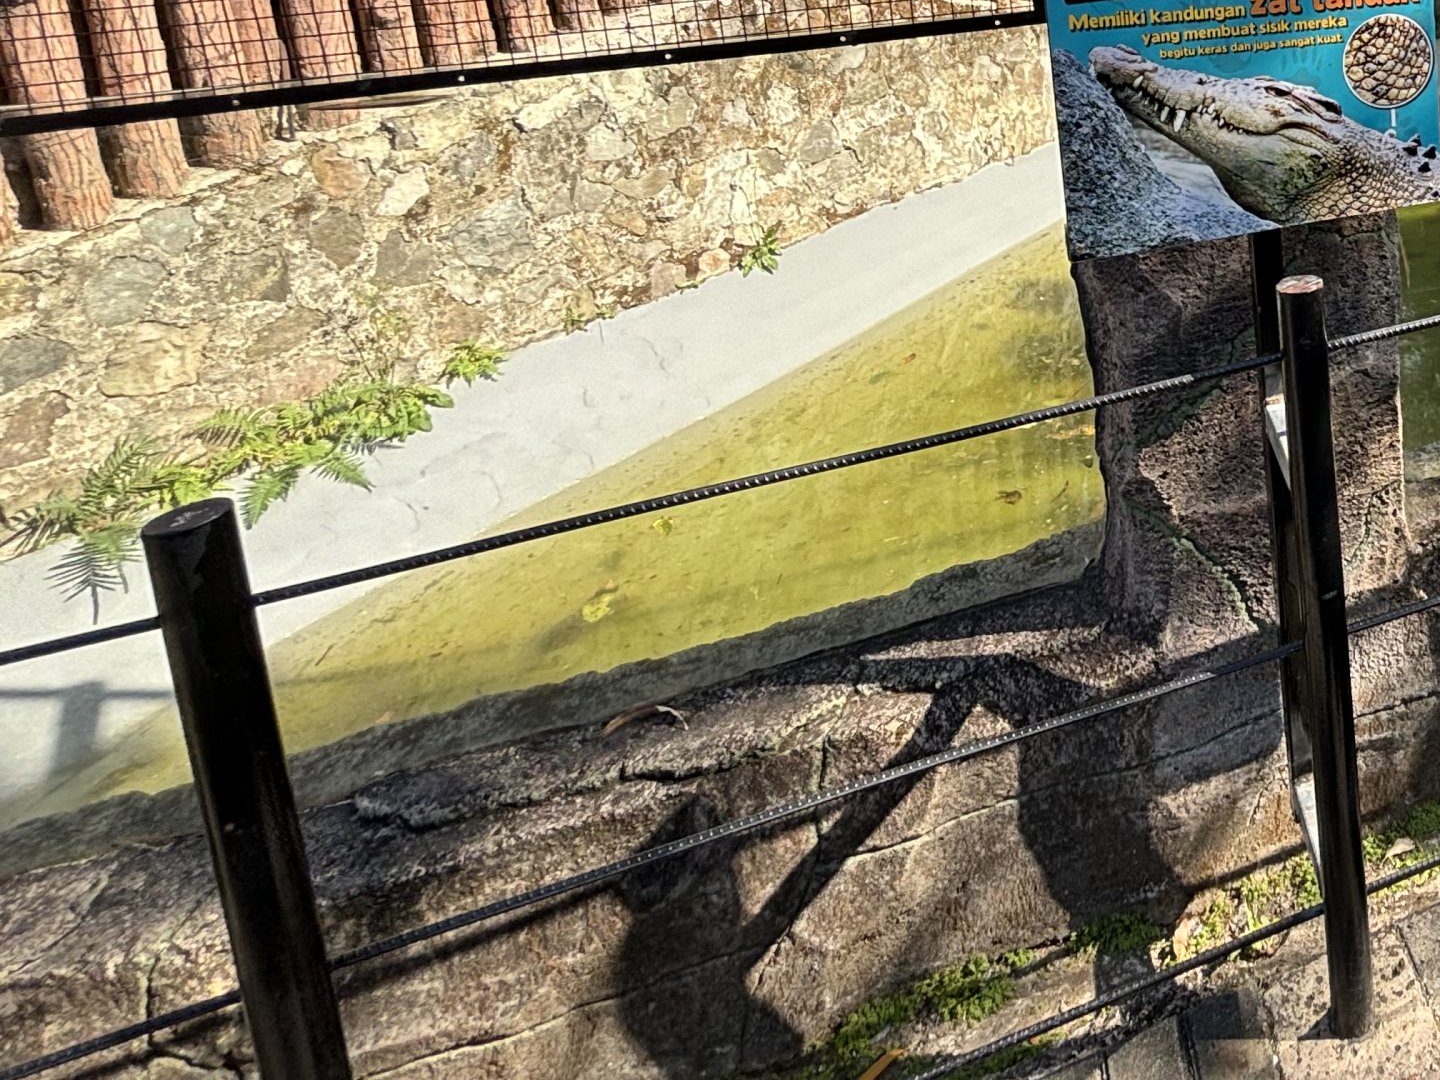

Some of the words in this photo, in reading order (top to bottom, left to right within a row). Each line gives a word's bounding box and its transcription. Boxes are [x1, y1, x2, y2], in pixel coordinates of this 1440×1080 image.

[1069, 9, 1145, 31] Memiliki
[1150, 5, 1245, 24] kandungan
[1142, 30, 1180, 46] yang
[1184, 23, 1255, 40] membuat
[1260, 20, 1290, 34] sisik
[1294, 16, 1347, 31] mereka
[1160, 45, 1195, 59] begitu
[1198, 43, 1227, 55] keras
[1231, 41, 1251, 52] dan
[1252, 40, 1276, 52] juga
[1279, 37, 1315, 49] sangat
